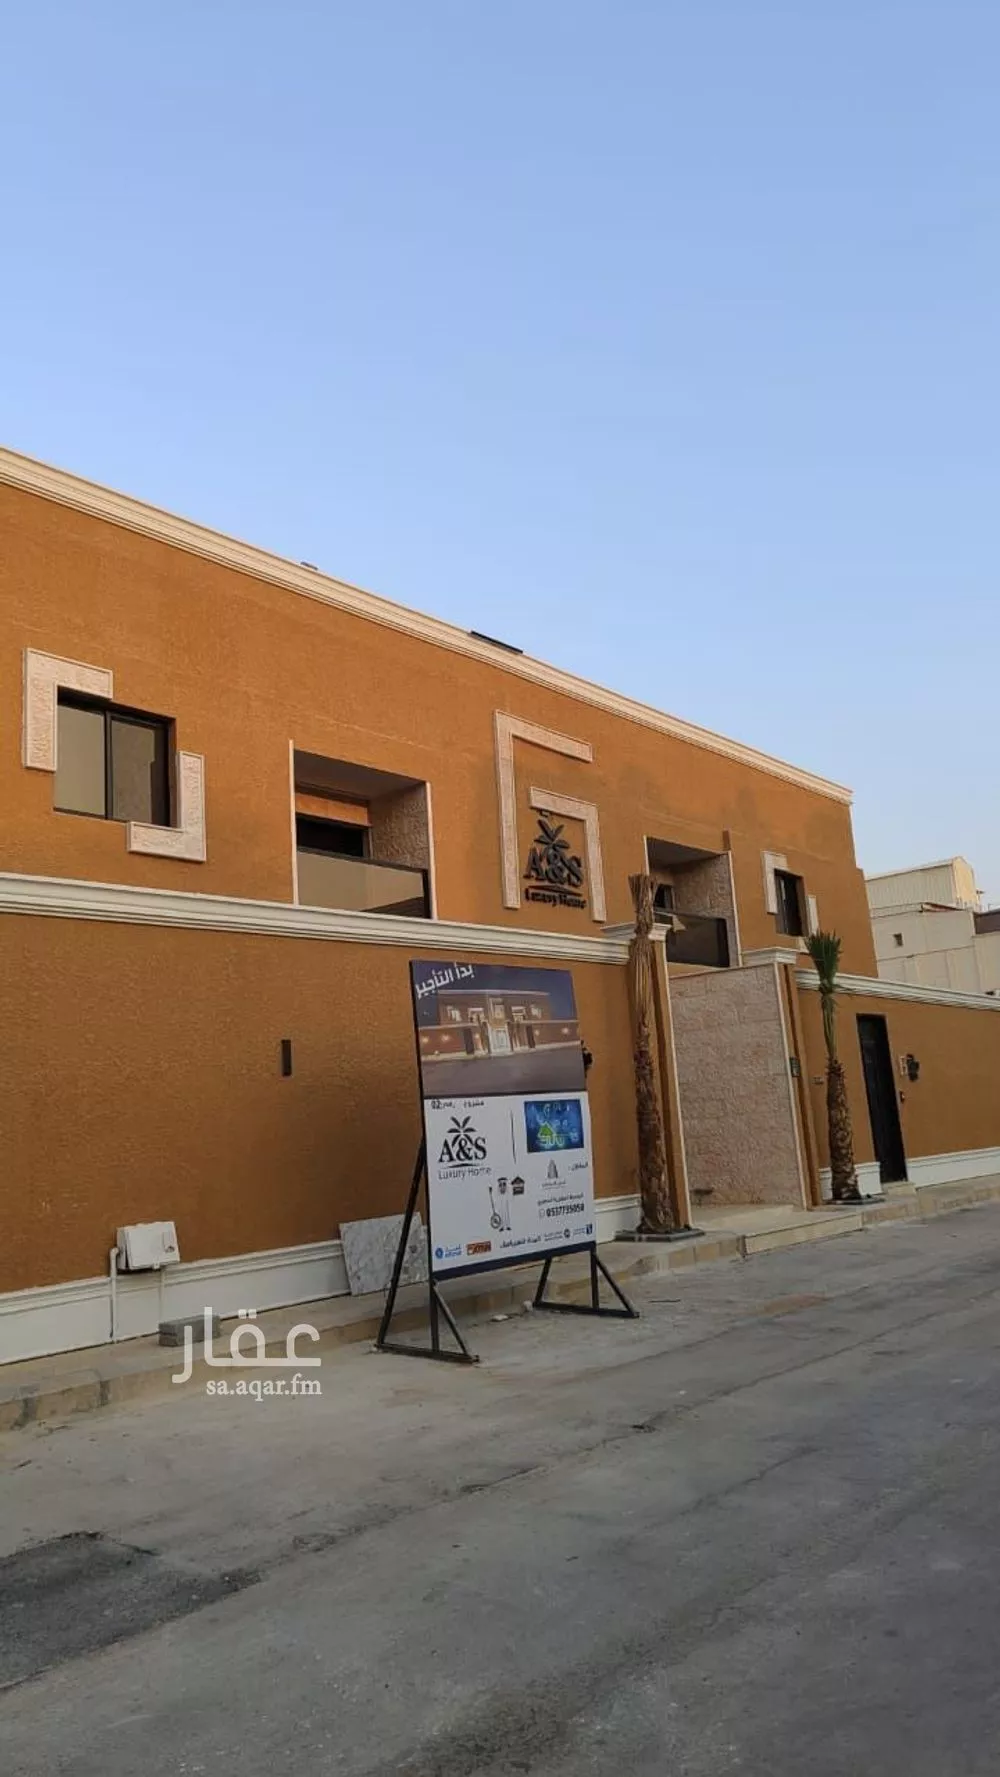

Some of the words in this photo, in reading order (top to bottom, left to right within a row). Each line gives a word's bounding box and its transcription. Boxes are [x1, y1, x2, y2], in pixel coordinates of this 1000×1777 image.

[523, 846, 584, 888] A&S
[415, 968, 454, 1000] التأجير
[454, 961, 476, 981] بدأ
[438, 1136, 488, 1163] A&S
[438, 1168, 466, 1180] Luxury
